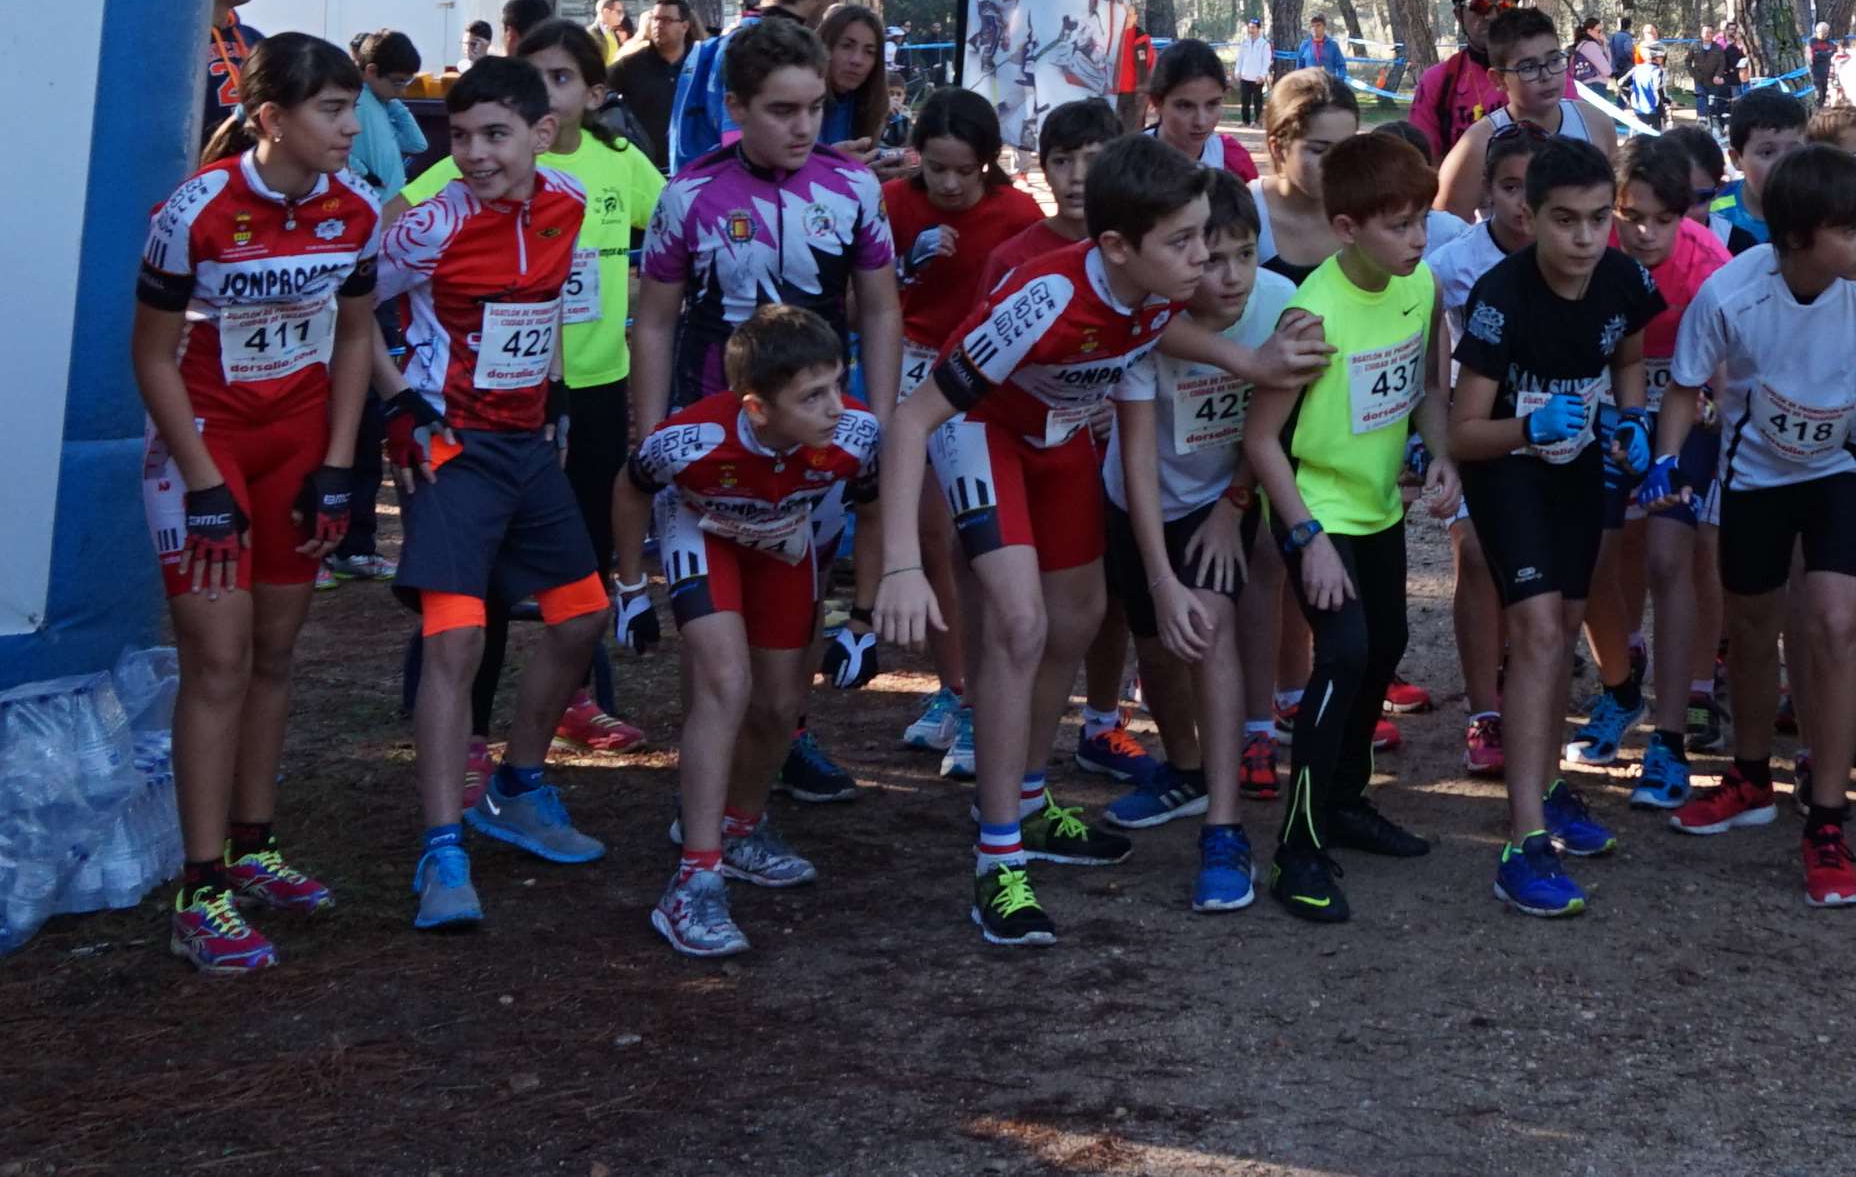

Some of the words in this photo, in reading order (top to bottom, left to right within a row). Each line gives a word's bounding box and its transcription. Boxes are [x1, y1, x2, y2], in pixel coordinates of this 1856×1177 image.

[244, 319, 311, 353] 411
[502, 326, 553, 359] 422
[1371, 355, 1420, 397] 437
[1769, 413, 1833, 442] 418
